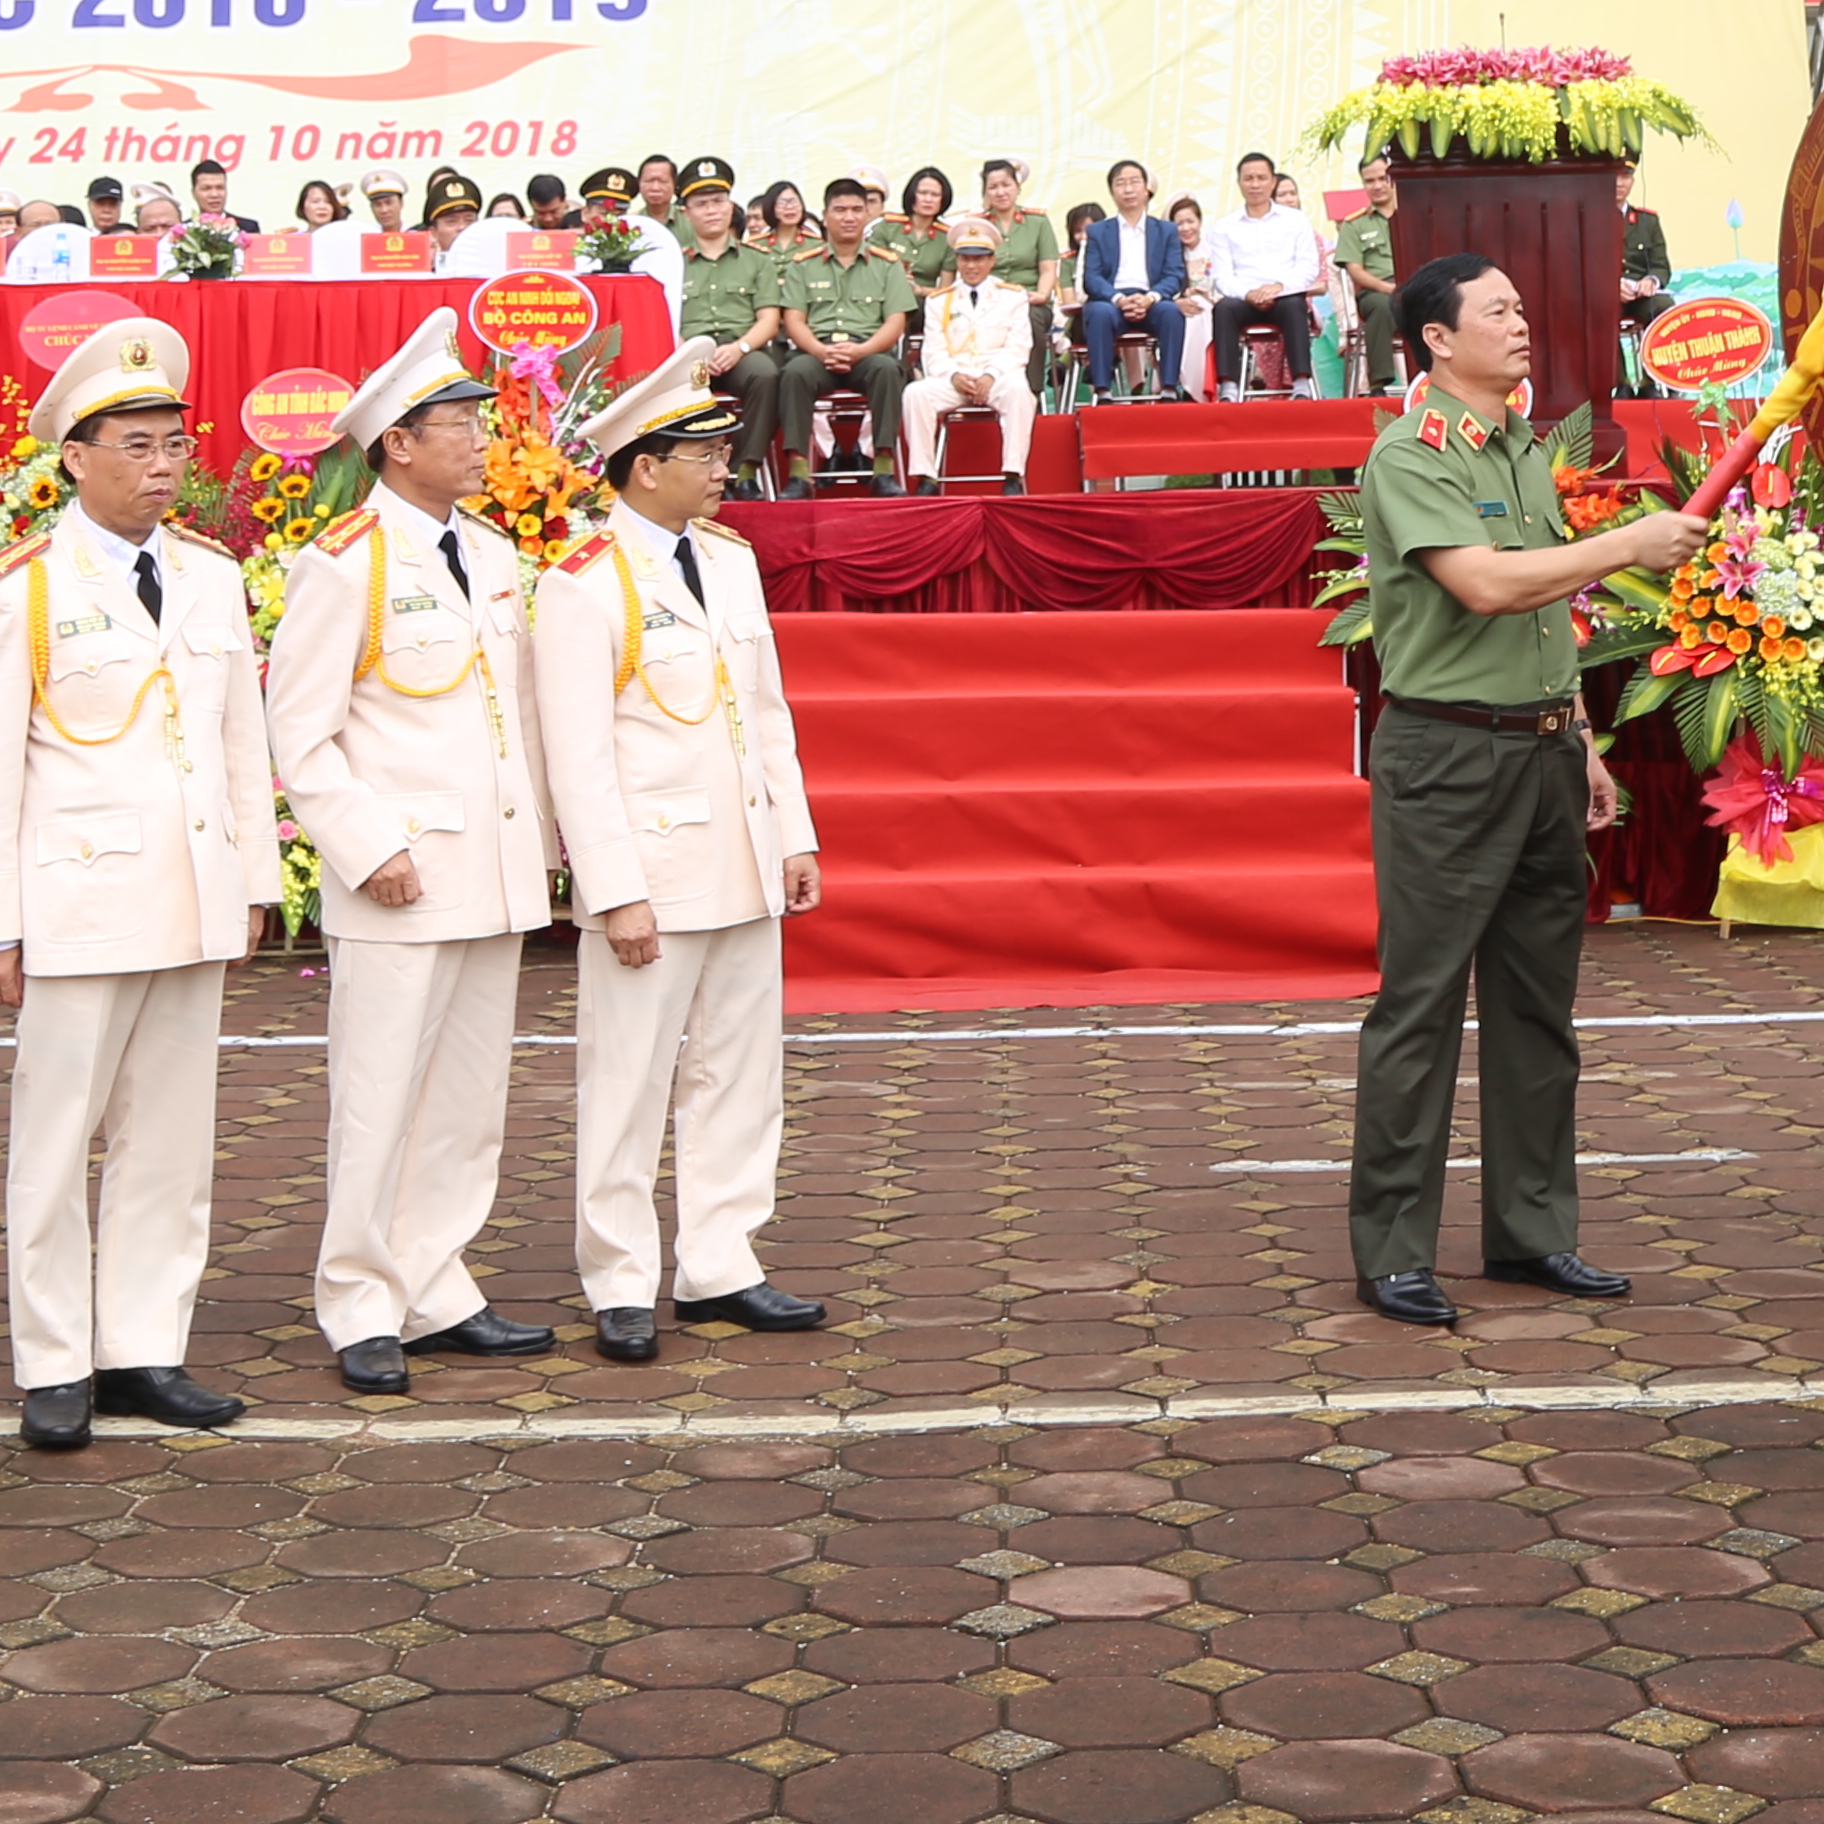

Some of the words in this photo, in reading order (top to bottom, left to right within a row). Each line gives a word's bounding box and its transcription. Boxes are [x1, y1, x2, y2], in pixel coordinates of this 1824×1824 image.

[28, 126, 87, 164] 24
[105, 122, 245, 171] tháng
[268, 124, 321, 161] 10
[336, 120, 443, 161] năm
[460, 120, 579, 158] 2018
[483, 309, 507, 328] BỘ
[510, 309, 558, 324] CÔNG
[561, 312, 587, 324] AN
[1651, 339, 1689, 367] HUYỆN
[1687, 331, 1725, 359] THUẬN
[1724, 324, 1762, 350] THÀNH
